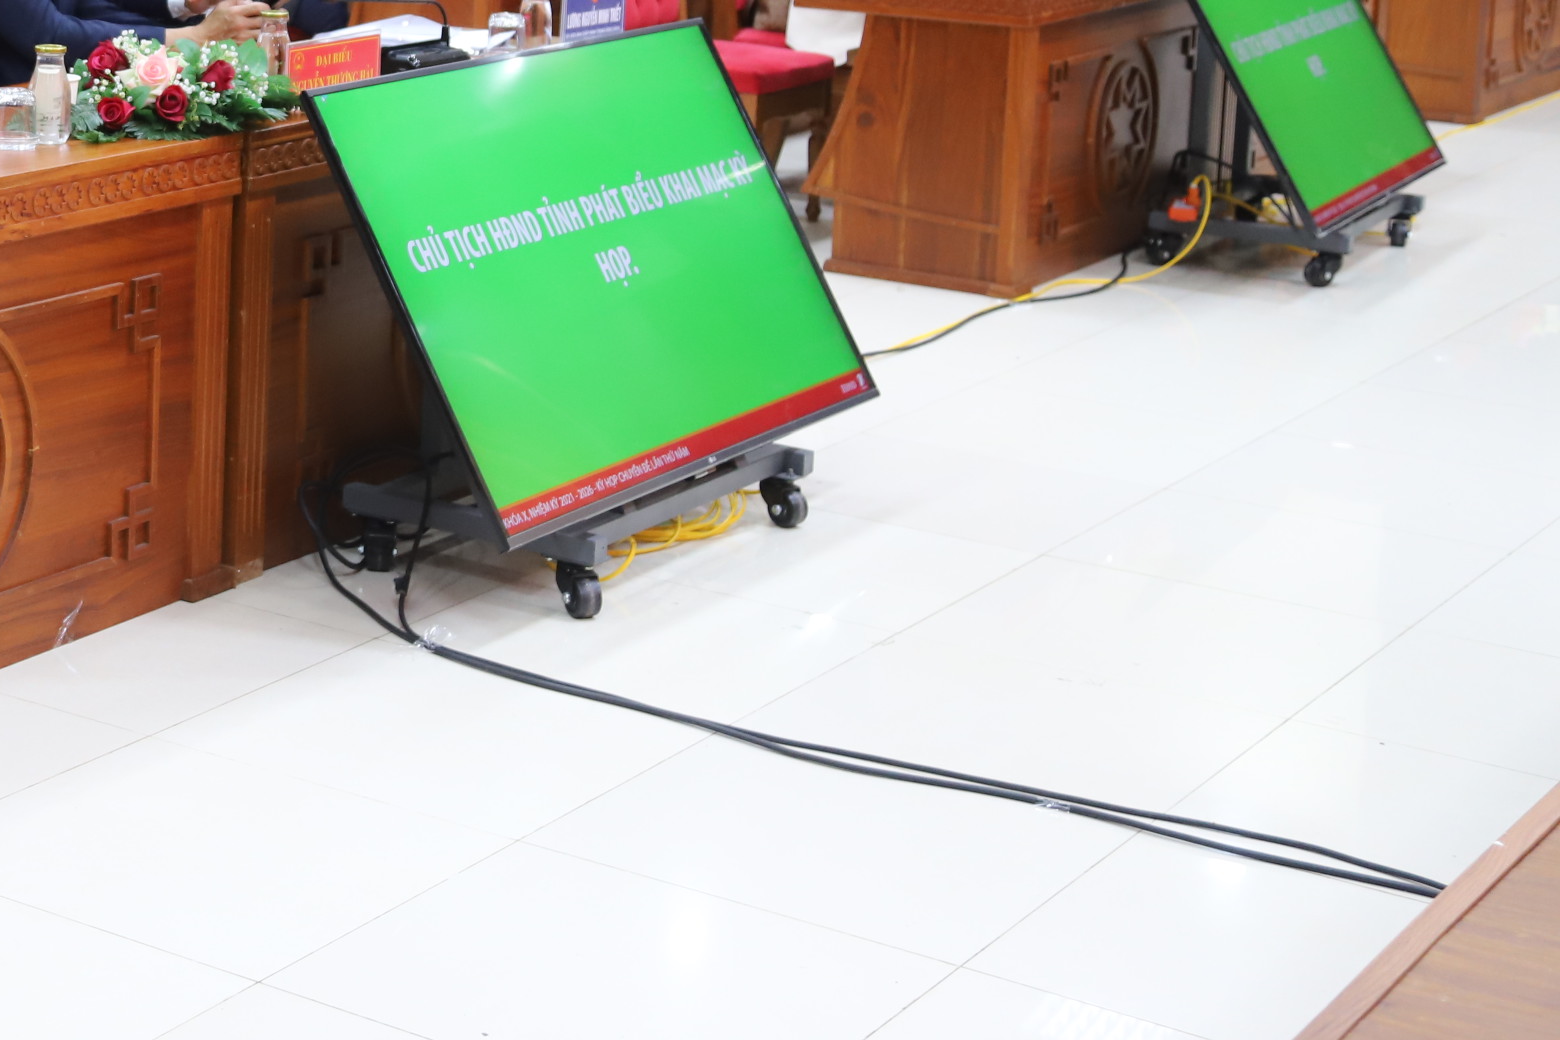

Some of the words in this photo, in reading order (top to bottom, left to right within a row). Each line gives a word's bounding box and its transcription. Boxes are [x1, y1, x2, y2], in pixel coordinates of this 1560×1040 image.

[316, 54, 331, 68] ĐẠI
[333, 45, 352, 64] BIỂU
[407, 225, 450, 273] CHỦ
[443, 223, 493, 269] TỊCH
[486, 210, 543, 252] HĐND
[536, 196, 586, 237] TỈNH
[578, 184, 626, 227] PHÁT
[621, 171, 664, 216] BIỂU
[658, 169, 702, 205] KHAI
[696, 160, 735, 199] MẠC
[728, 150, 753, 186] KỲ
[594, 246, 640, 287] HỌP.
[502, 512, 524, 529] KHÓA
[528, 501, 551, 518] NHIỆM
[550, 496, 559, 510] KỲ
[559, 492, 575, 507] 2021
[577, 485, 594, 499] 2026
[604, 474, 618, 488] HỌP
[618, 463, 643, 482] CHUYÊN
[674, 446, 691, 460] NĂM
